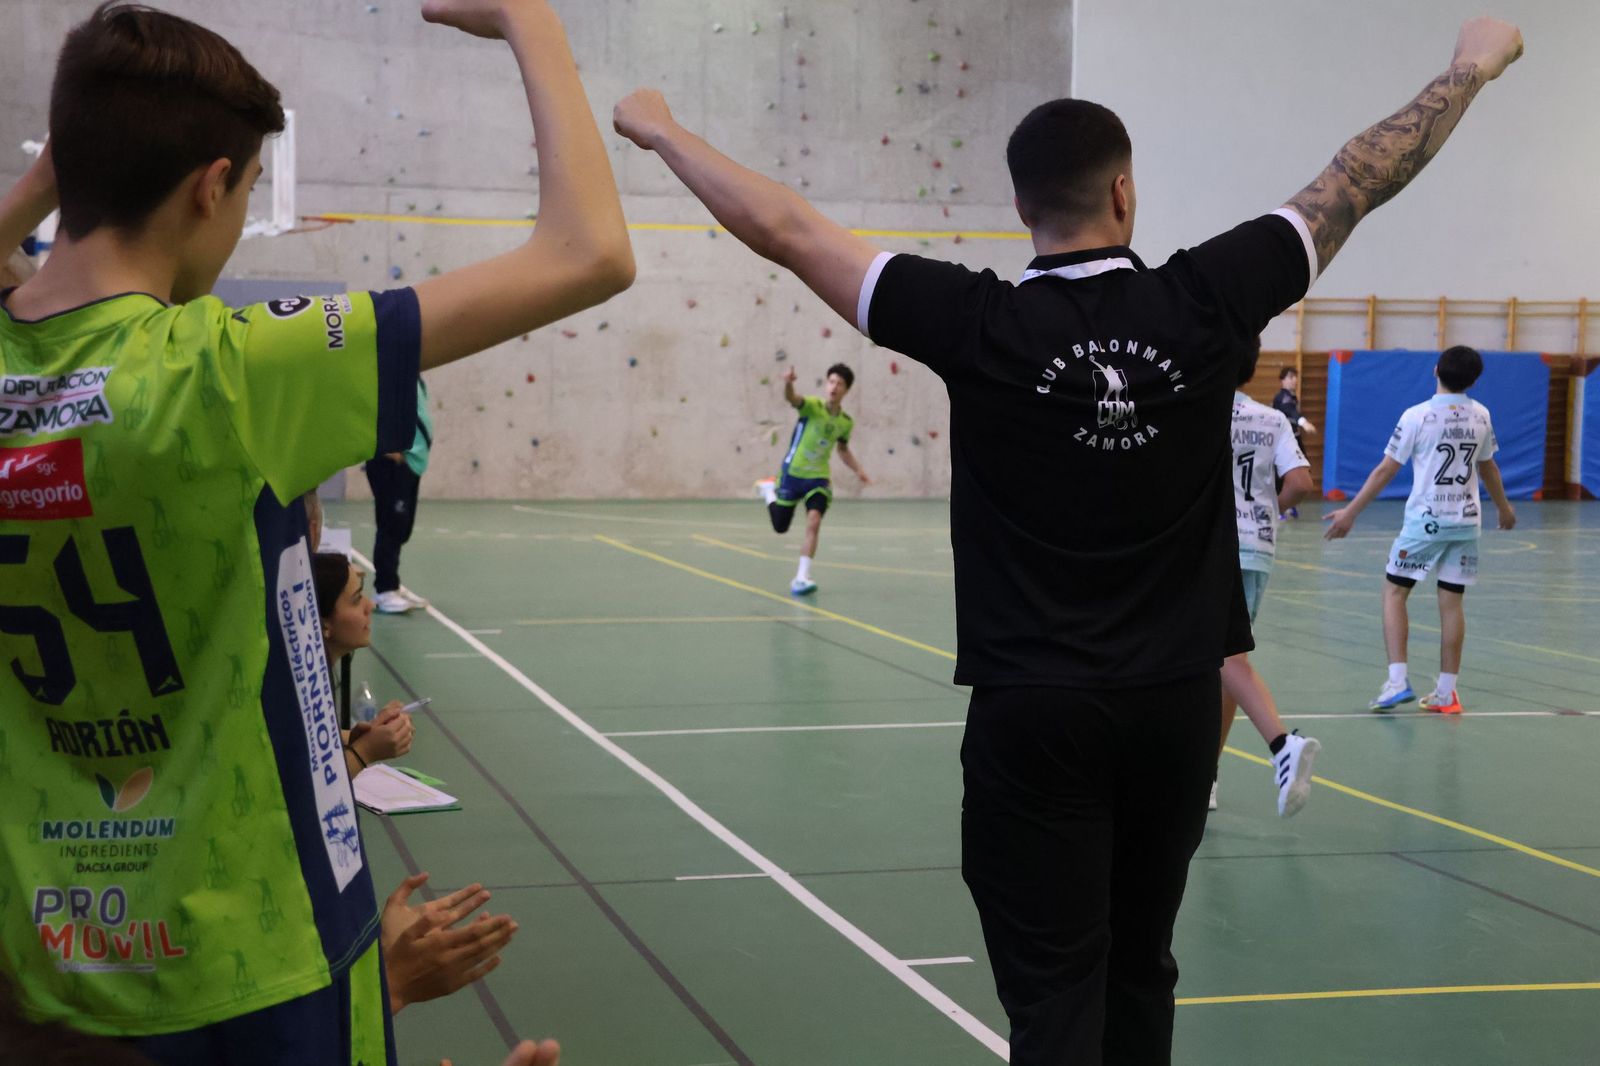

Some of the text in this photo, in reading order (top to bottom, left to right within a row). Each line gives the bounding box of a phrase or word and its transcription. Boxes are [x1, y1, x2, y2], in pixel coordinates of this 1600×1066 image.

[0, 395, 109, 433] ZAMORA
[1073, 424, 1159, 451] ZAMORA
[1231, 429, 1274, 447] ANDRO
[36, 463, 58, 477] sgc
[1434, 443, 1478, 486] 23
[0, 480, 83, 509] gregorio
[1394, 560, 1431, 572] UEMC
[0, 526, 185, 706] 54
[305, 579, 322, 655] Tensión
[280, 589, 319, 773] Montajes Eléctricos
[319, 654, 330, 697] Baja
[46, 709, 171, 758] ADRIÁN
[330, 713, 341, 750] Alta
[42, 818, 174, 840] MOLENDUM
[60, 842, 159, 858] INGREDIENTS
[76, 861, 150, 874] DACSA GROUP
[34, 886, 126, 925] PRO
